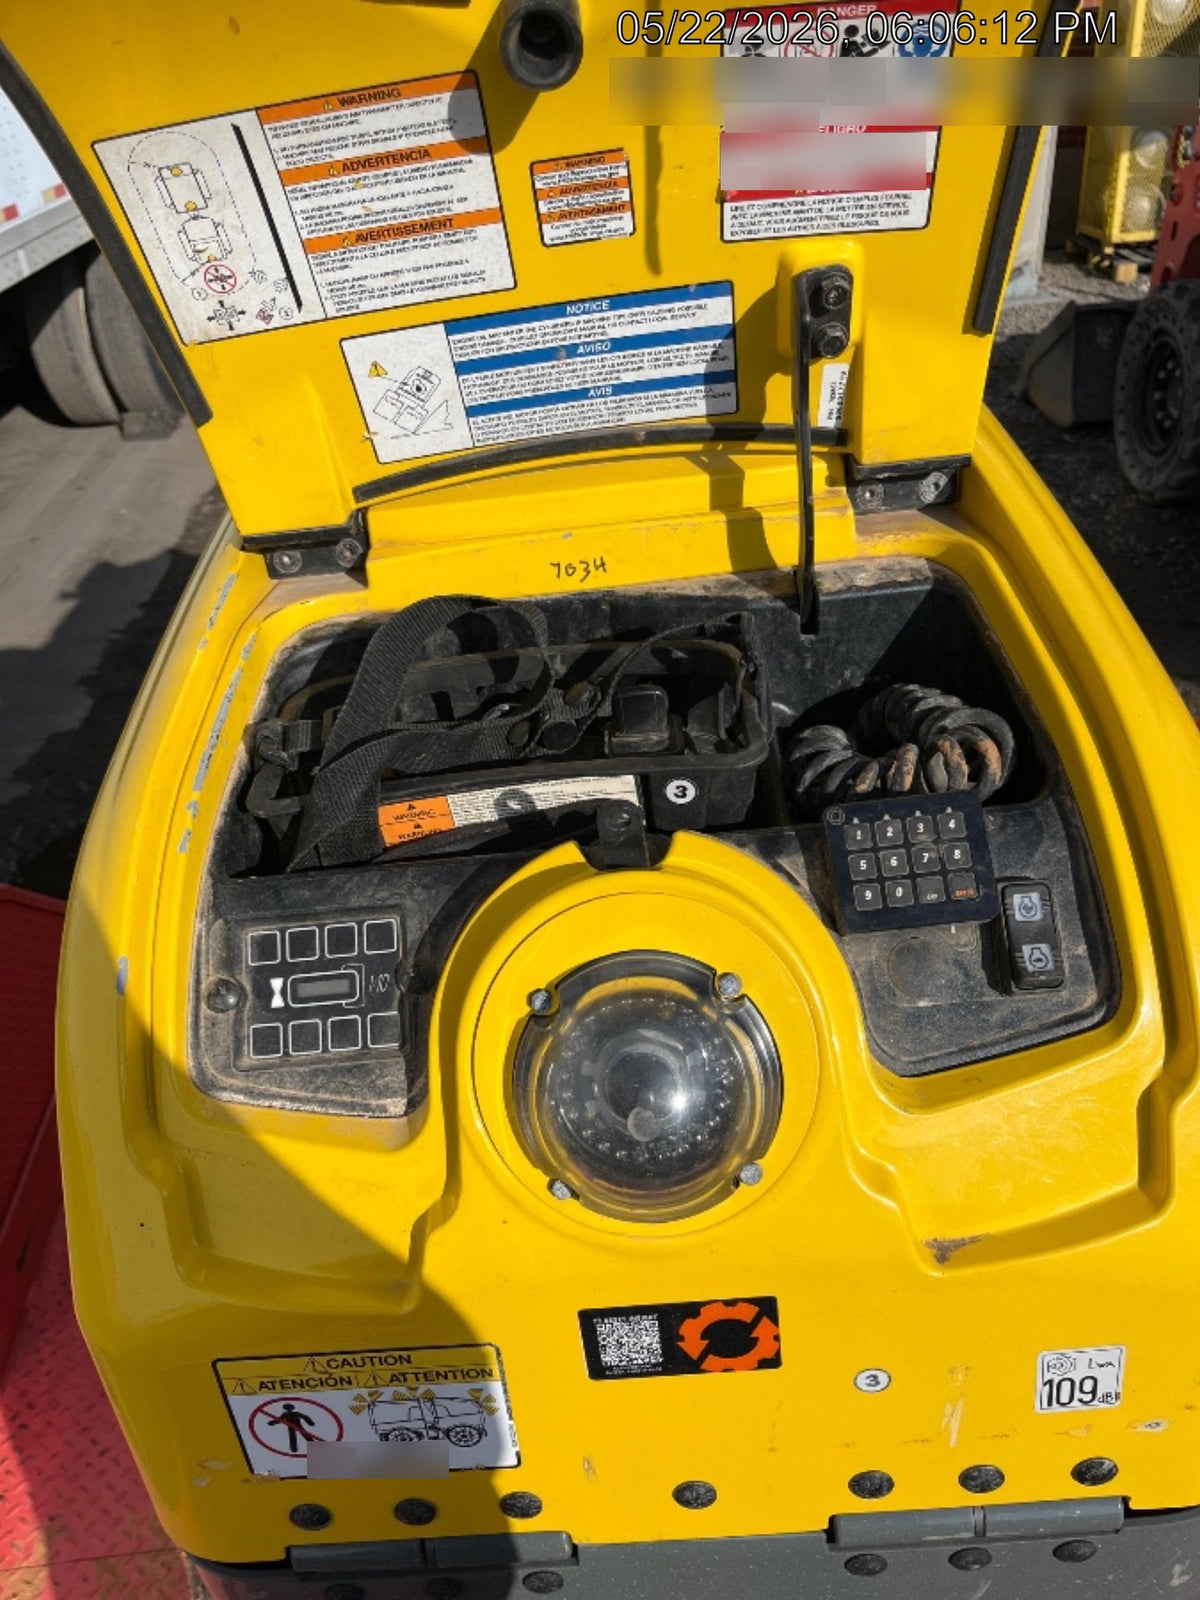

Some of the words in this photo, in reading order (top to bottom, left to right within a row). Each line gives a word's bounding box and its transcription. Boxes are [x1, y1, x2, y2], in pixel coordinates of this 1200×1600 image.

[337, 88, 402, 107] WARNING
[342, 149, 432, 173] ADVERTENCIA
[355, 218, 454, 244] AVERTISSEMENT
[566, 300, 611, 315] NOTICE
[577, 341, 612, 355] AVISO
[588, 387, 613, 398] AVIS
[550, 556, 607, 583] 7034
[674, 785, 688, 798] 3
[856, 830, 862, 840] 1
[886, 826, 893, 837] 2
[917, 823, 924, 833] 3
[948, 819, 956, 829] 4
[860, 860, 867, 870] 5
[890, 857, 897, 867] 6
[922, 853, 929, 863] 7
[954, 849, 961, 860] 8
[865, 890, 872, 900] 9
[326, 1354, 413, 1370] CAUTION
[258, 1373, 352, 1392] ATENCIÓN
[389, 1368, 494, 1385] ATTENTION
[865, 1373, 881, 1387] 3
[1043, 1375, 1098, 1407] 109
